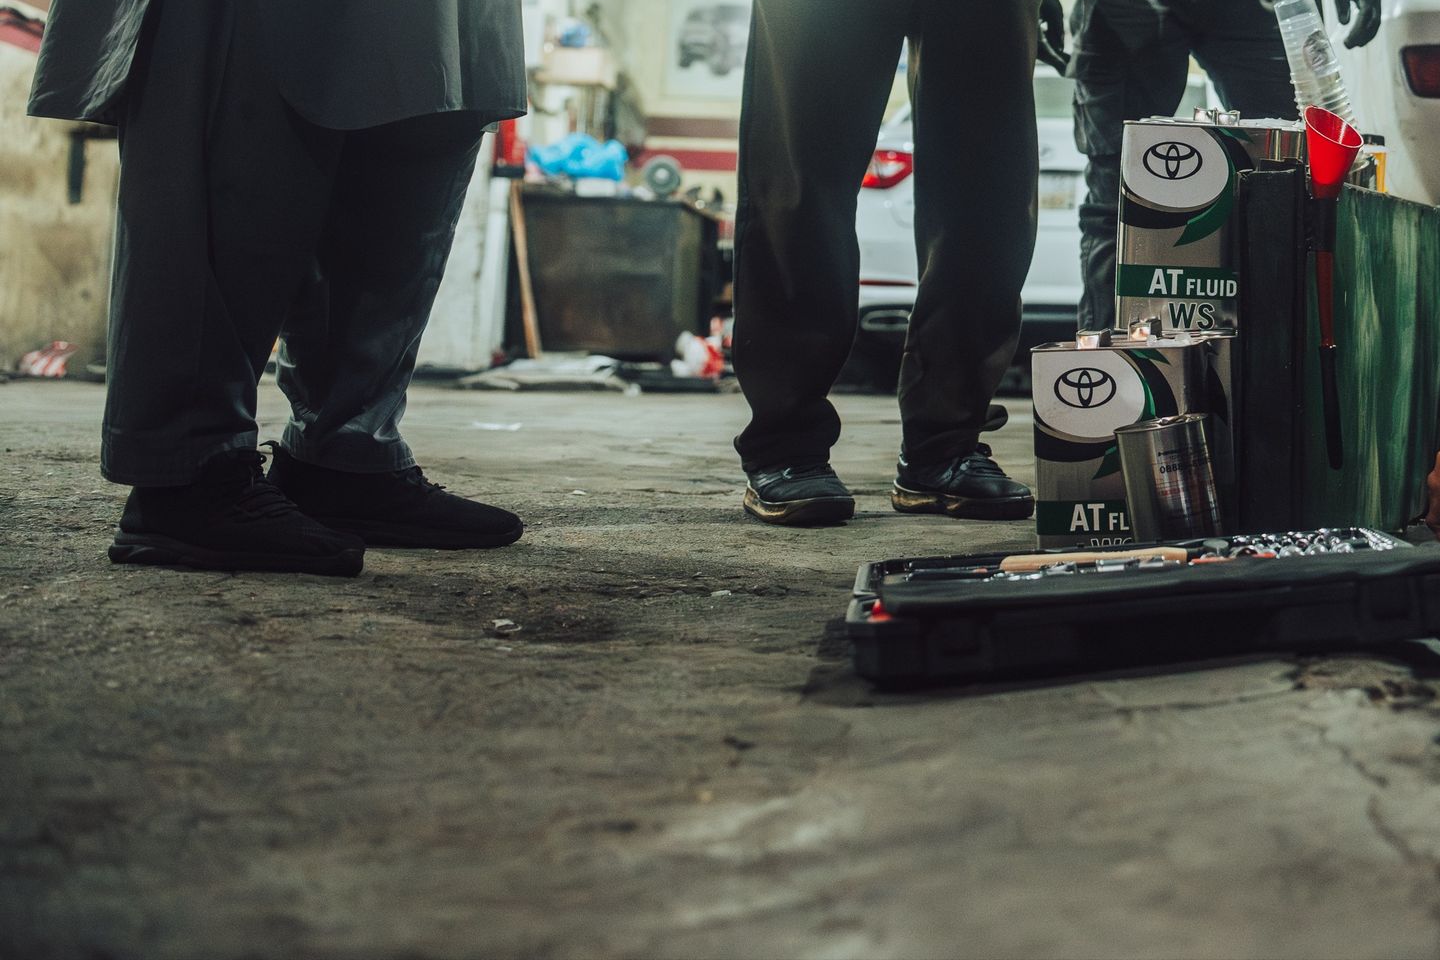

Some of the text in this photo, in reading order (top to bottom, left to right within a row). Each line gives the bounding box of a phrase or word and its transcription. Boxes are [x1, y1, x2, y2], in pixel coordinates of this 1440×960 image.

[1148, 268, 1238, 297] AT FLUID
[1168, 302, 1216, 330] WS
[1069, 503, 1105, 532] AT
